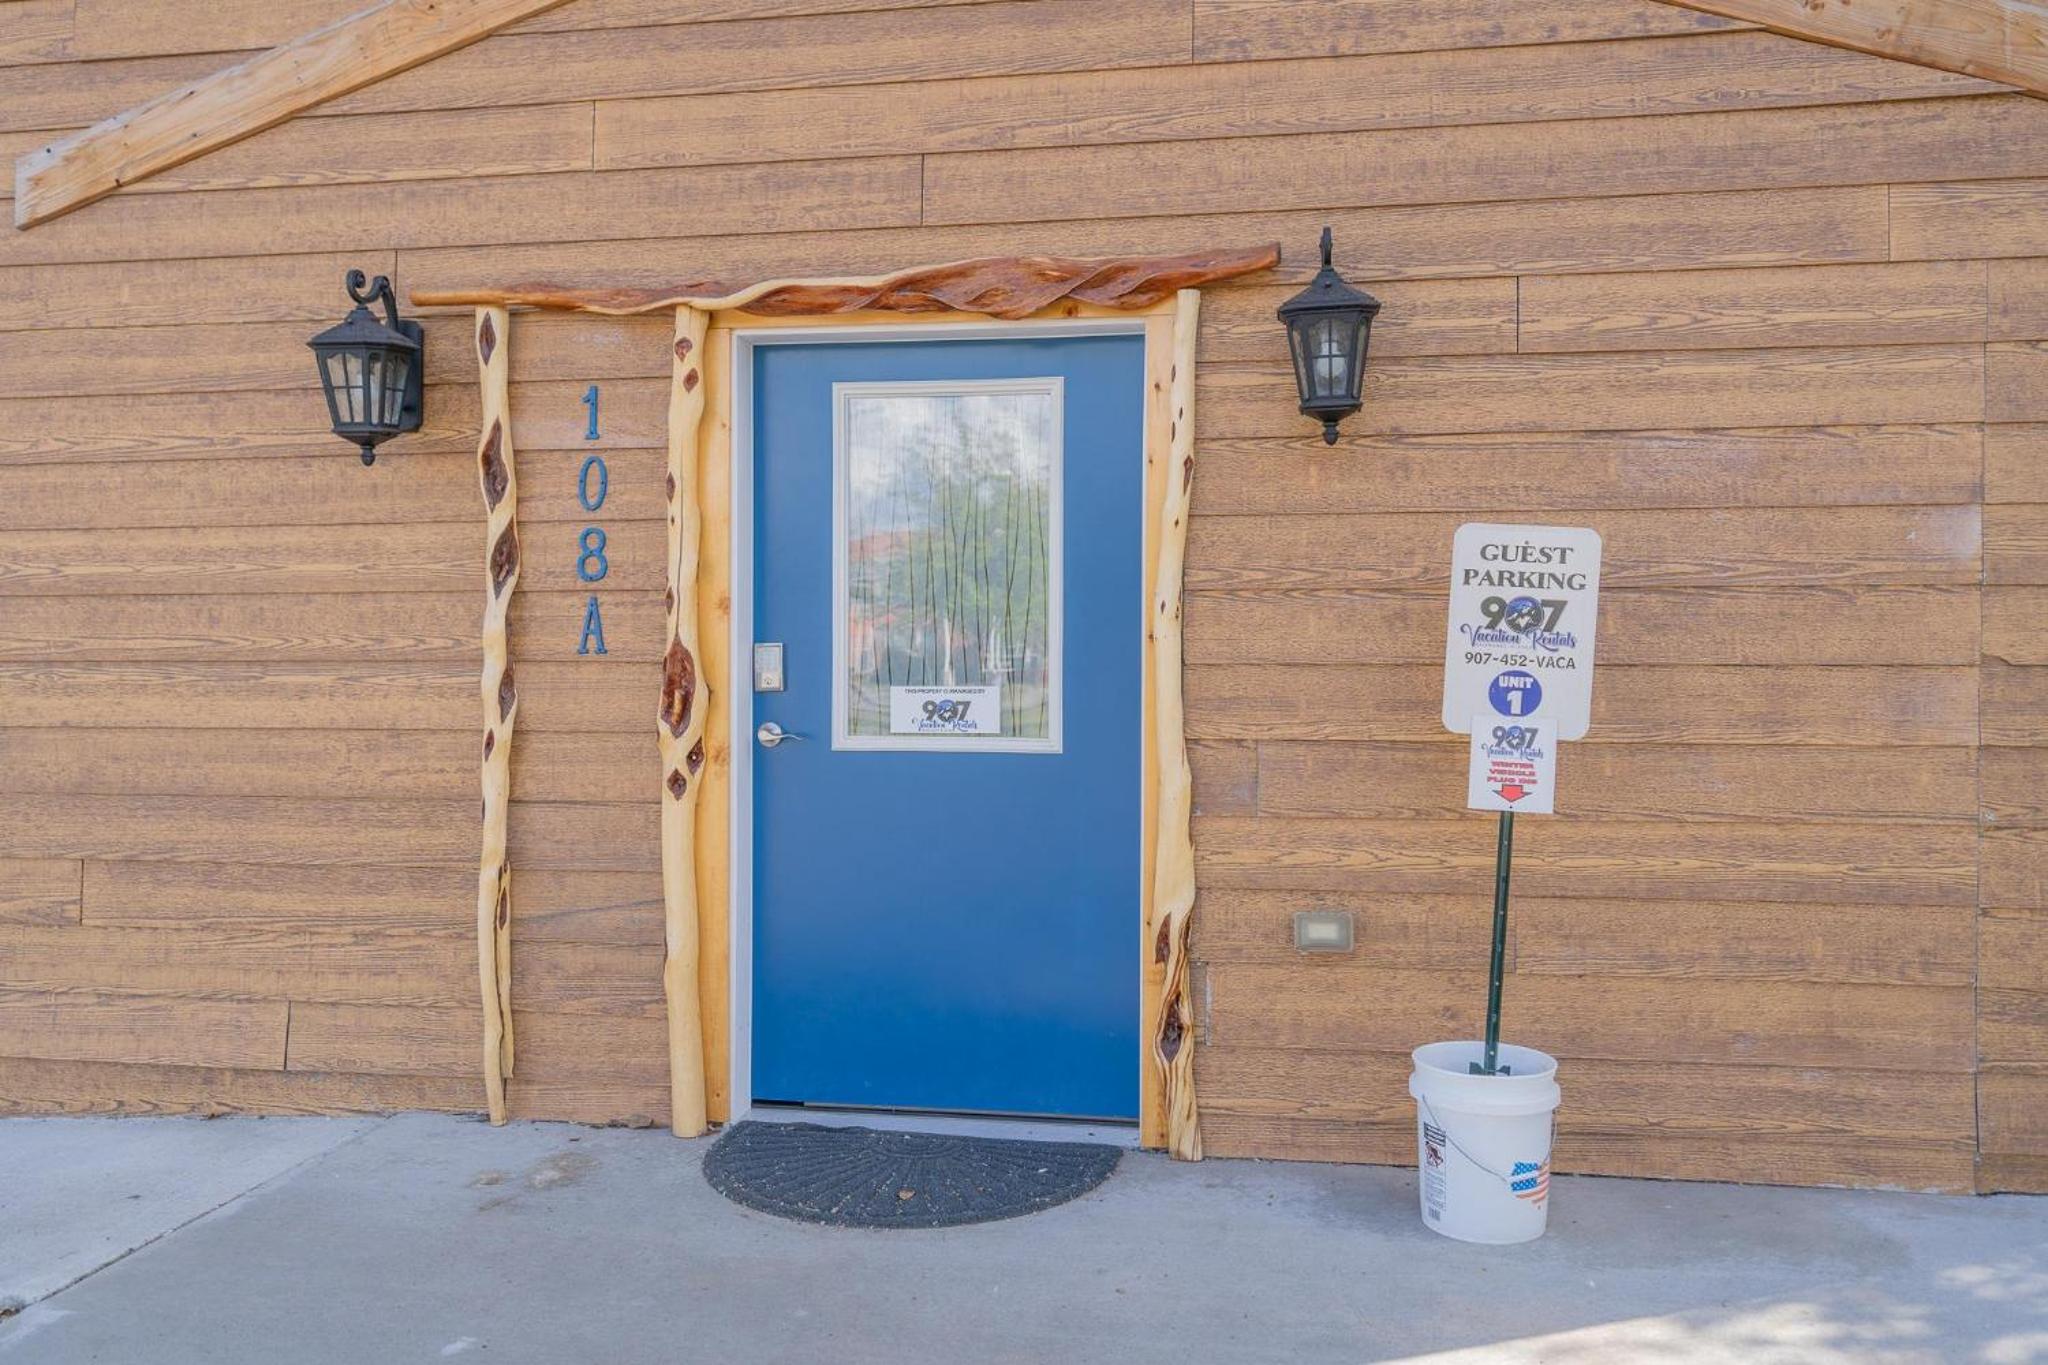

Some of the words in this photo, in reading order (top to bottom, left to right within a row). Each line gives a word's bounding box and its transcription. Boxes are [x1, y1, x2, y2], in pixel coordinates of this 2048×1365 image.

[1480, 543, 1574, 565] GUEST
[1463, 568, 1587, 591] PARKING
[1480, 596, 1568, 633] 907
[1460, 623, 1520, 647] Vacation
[1521, 629, 1577, 652] Rentals
[1464, 651, 1576, 669] 907-452-VACA
[1498, 675, 1534, 689] UNIT
[1506, 690, 1522, 715] 1
